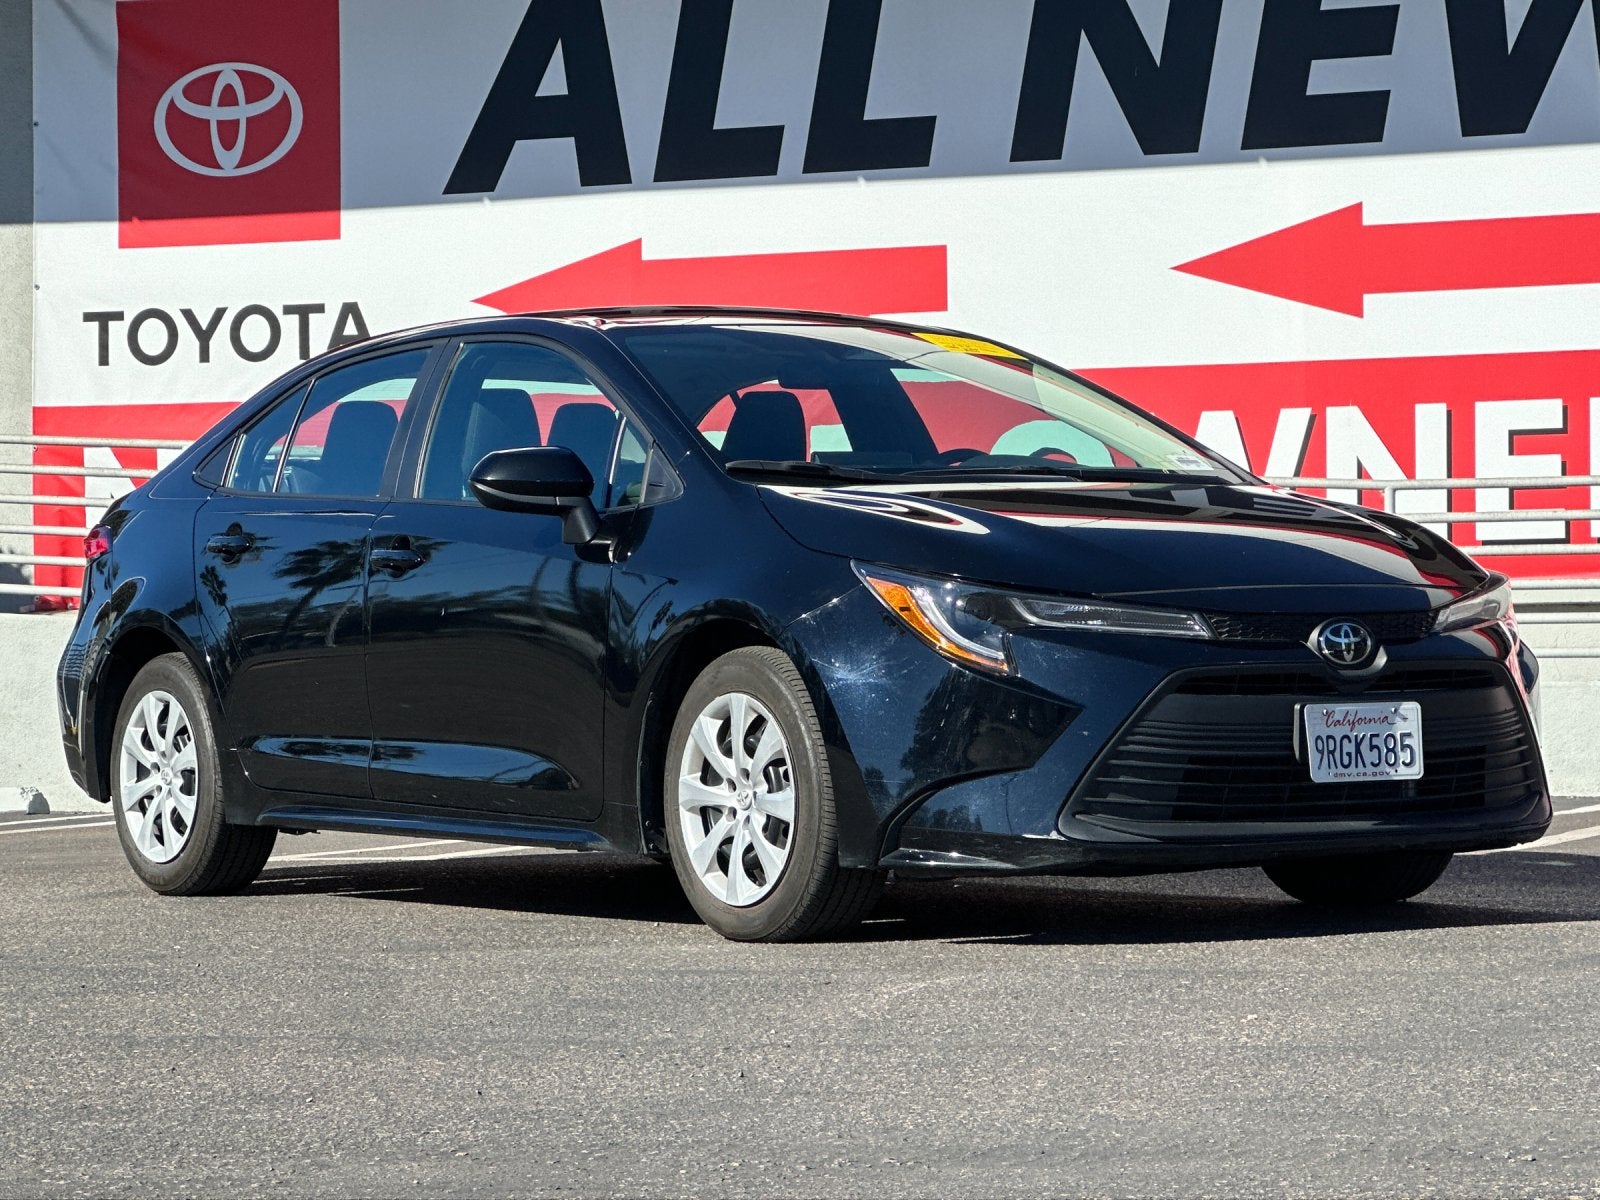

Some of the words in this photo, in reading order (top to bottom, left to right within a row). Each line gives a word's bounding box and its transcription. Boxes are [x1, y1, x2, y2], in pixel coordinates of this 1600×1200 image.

[442, 0, 937, 195] ALL
[82, 301, 371, 366] TOYOTA
[1325, 710, 1396, 732] California
[1315, 732, 1416, 769] 9RGK585
[1333, 770, 1391, 778] dmv.ca.gov
